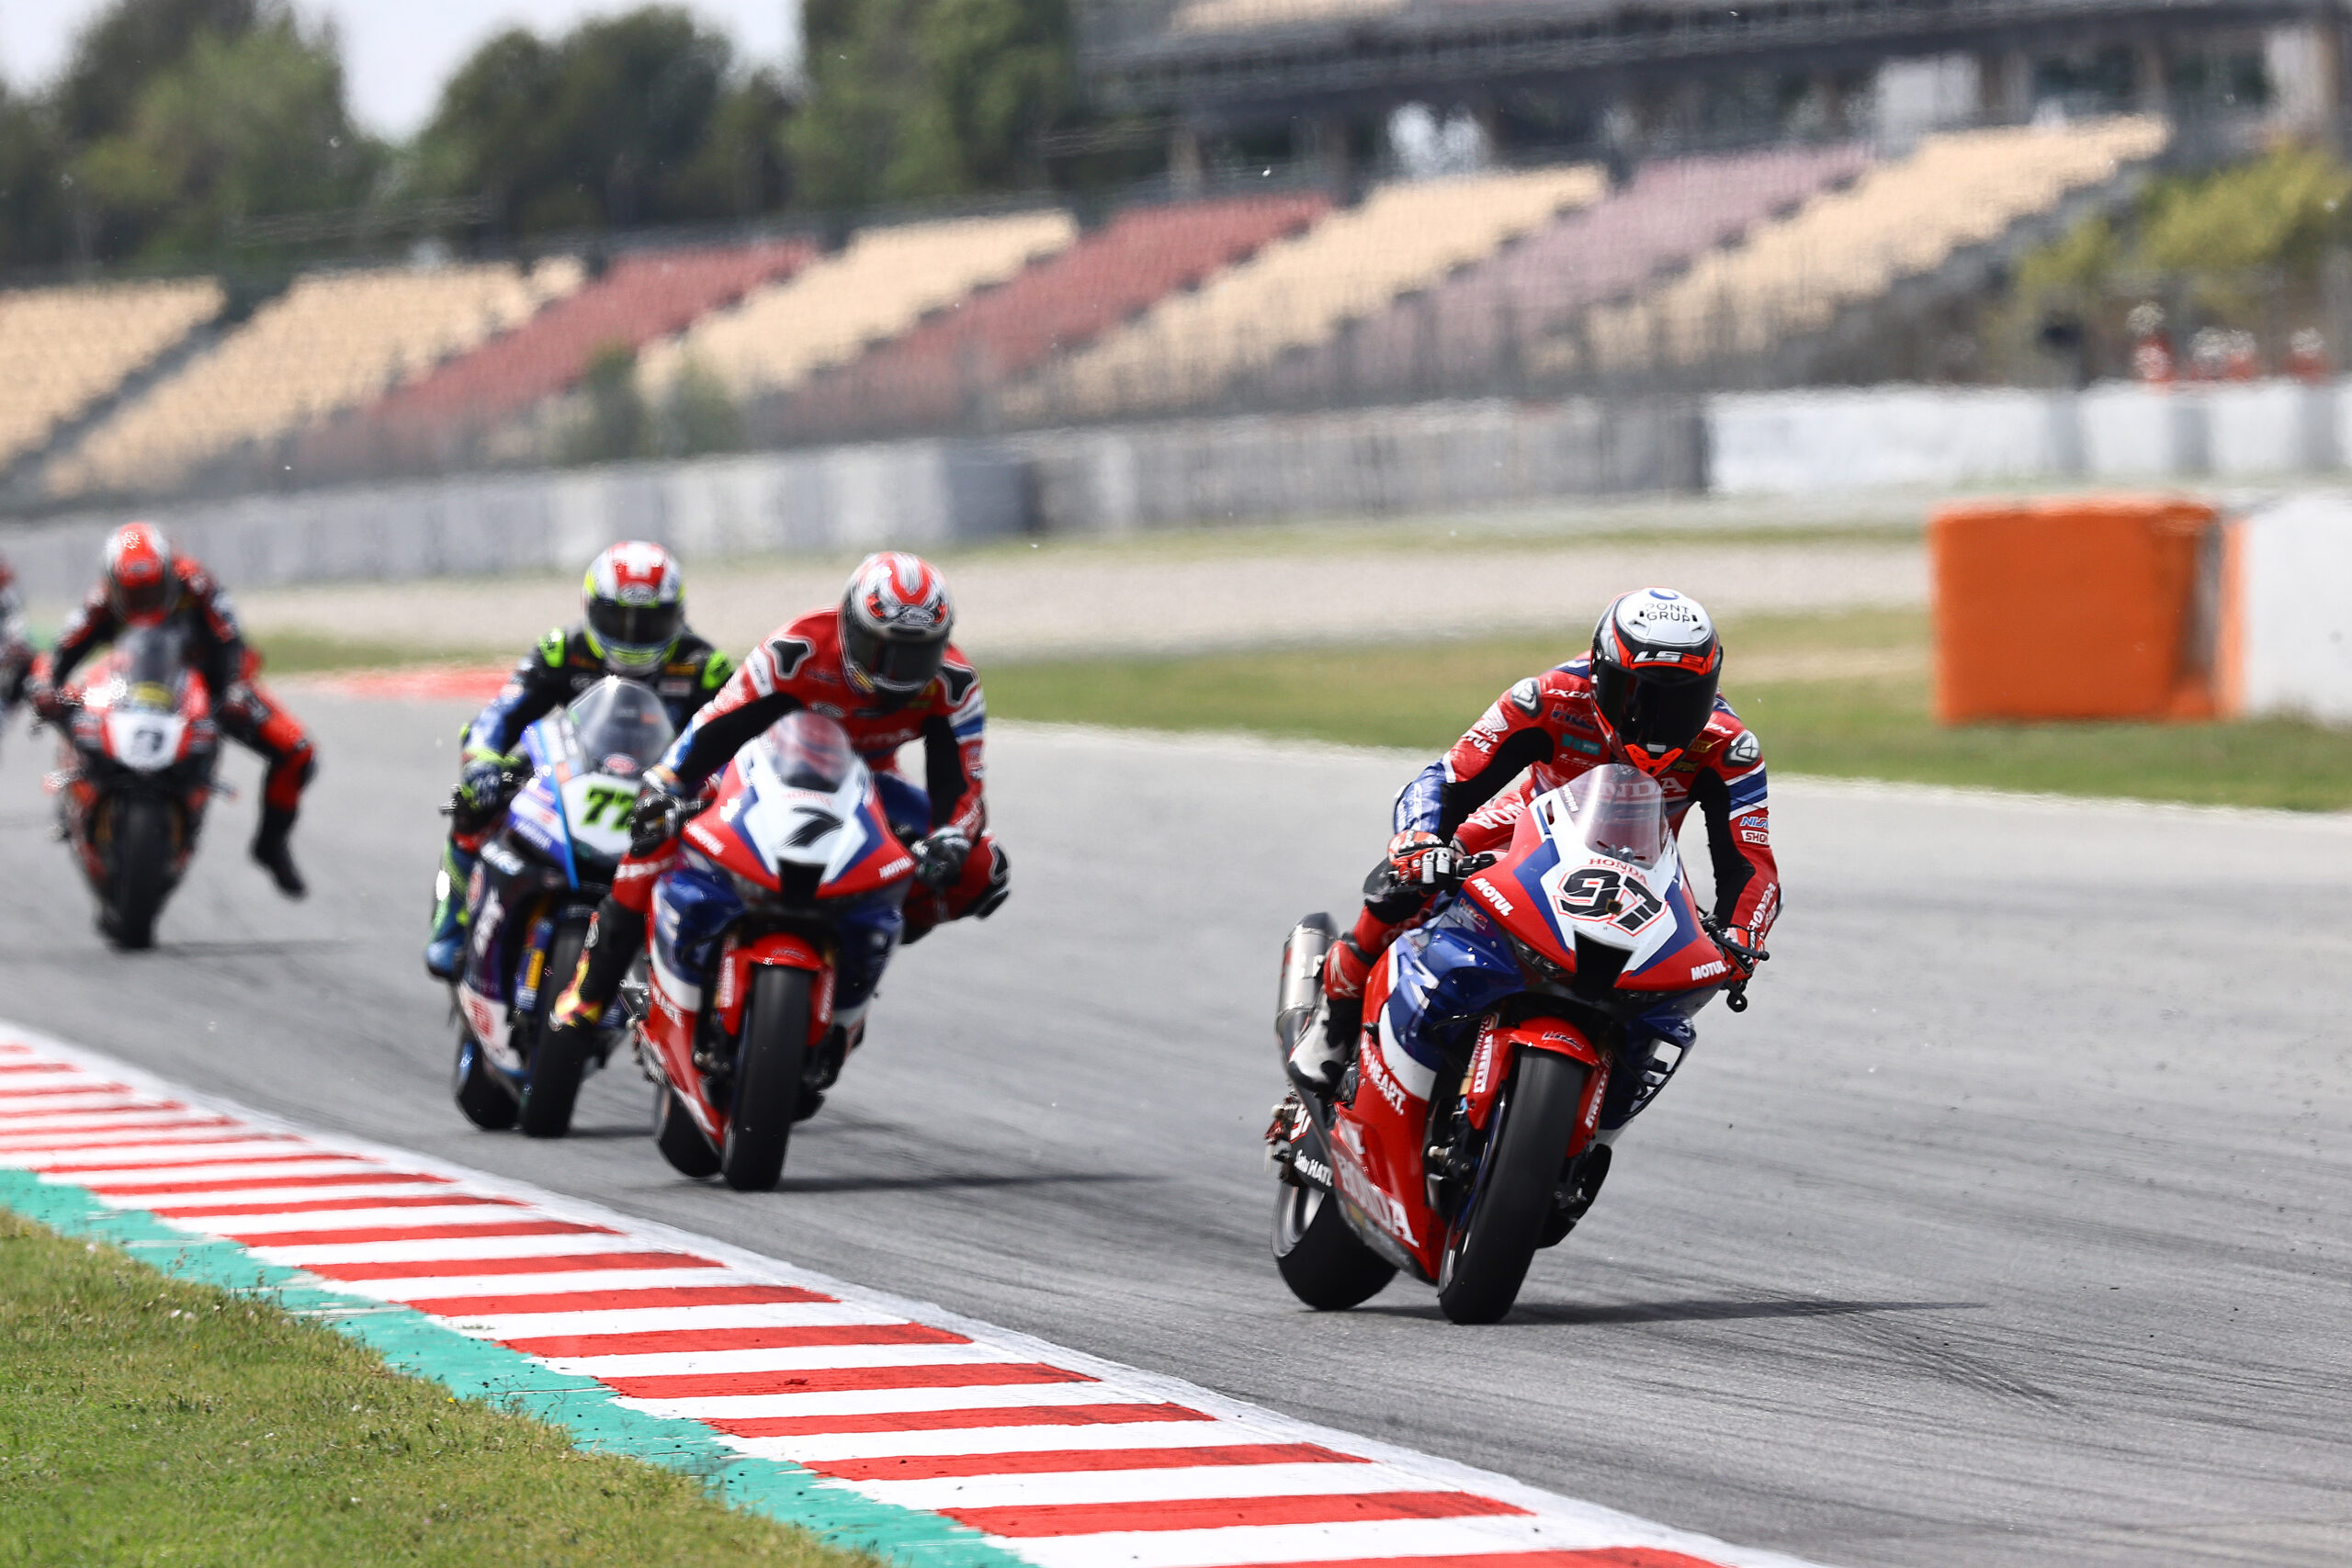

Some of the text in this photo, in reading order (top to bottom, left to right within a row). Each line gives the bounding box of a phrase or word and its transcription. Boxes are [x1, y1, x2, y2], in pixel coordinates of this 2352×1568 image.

[1646, 611, 1690, 623] GRUP
[581, 786, 636, 830] 77
[779, 807, 844, 848] 7
[1589, 858, 1647, 884] HONDA
[1471, 877, 1514, 917] MOTUL
[1560, 868, 1664, 932] 97
[1690, 960, 1726, 981] MOTUL
